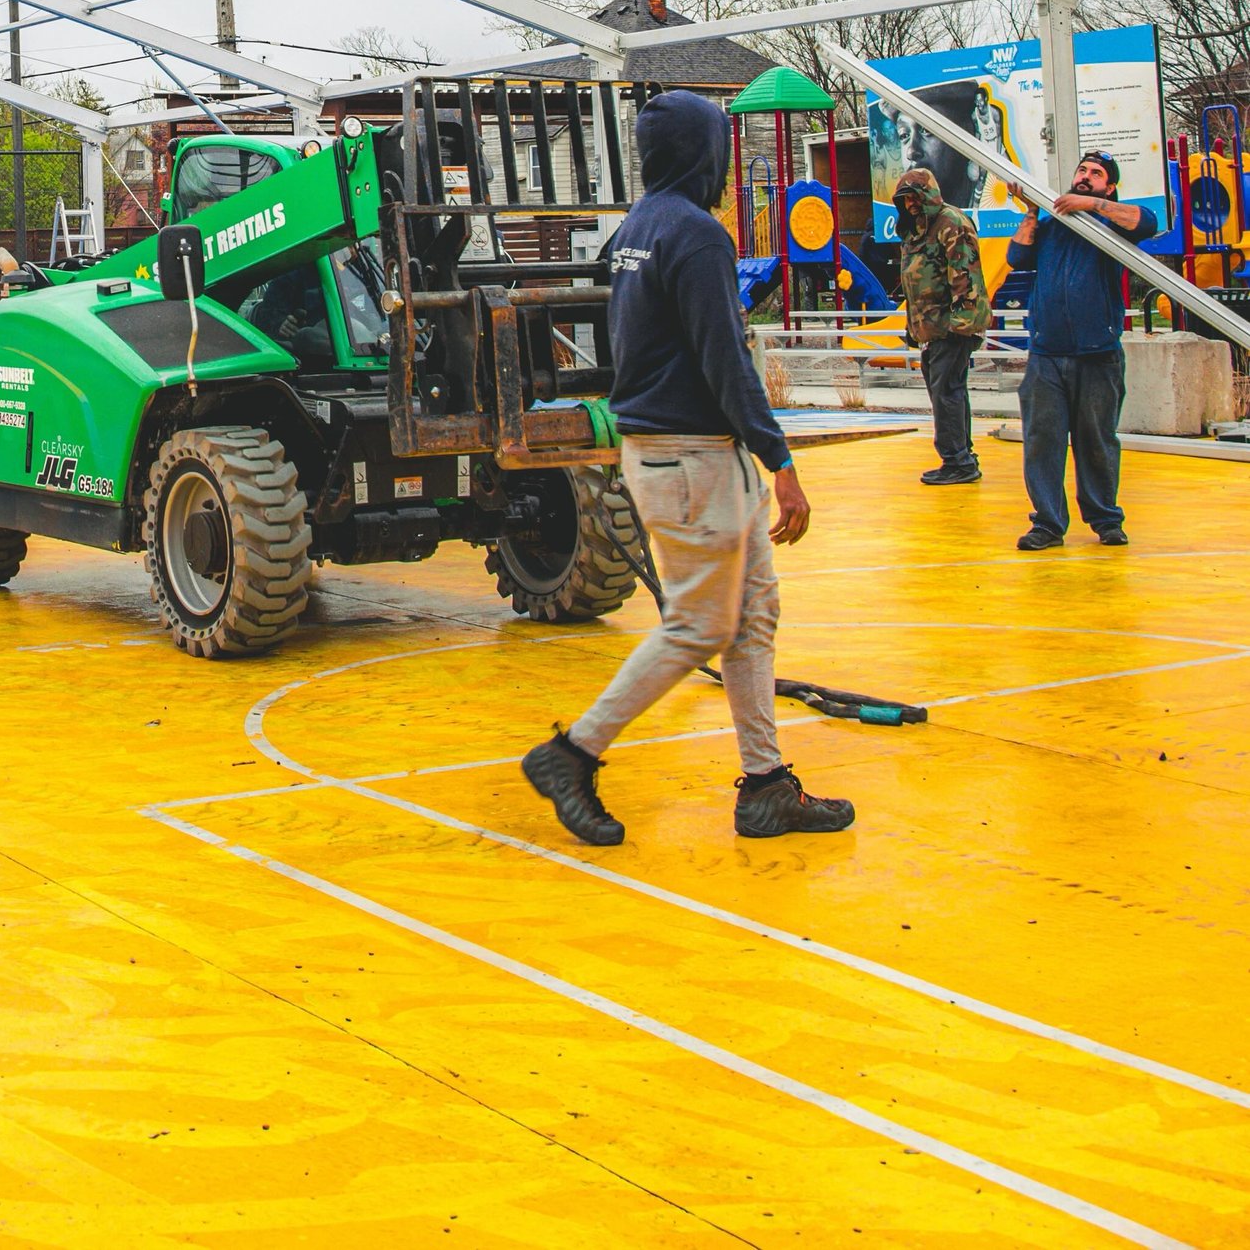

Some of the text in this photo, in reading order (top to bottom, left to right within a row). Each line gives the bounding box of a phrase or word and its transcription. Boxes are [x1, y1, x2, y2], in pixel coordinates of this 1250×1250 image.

[992, 47, 1014, 63] NW
[1018, 79, 1030, 92] The
[216, 202, 286, 255] RENTALS
[1, 383, 29, 392] RENTALS
[41, 439, 84, 457] CLEARSKY
[36, 455, 114, 497] JLG G5-18A
